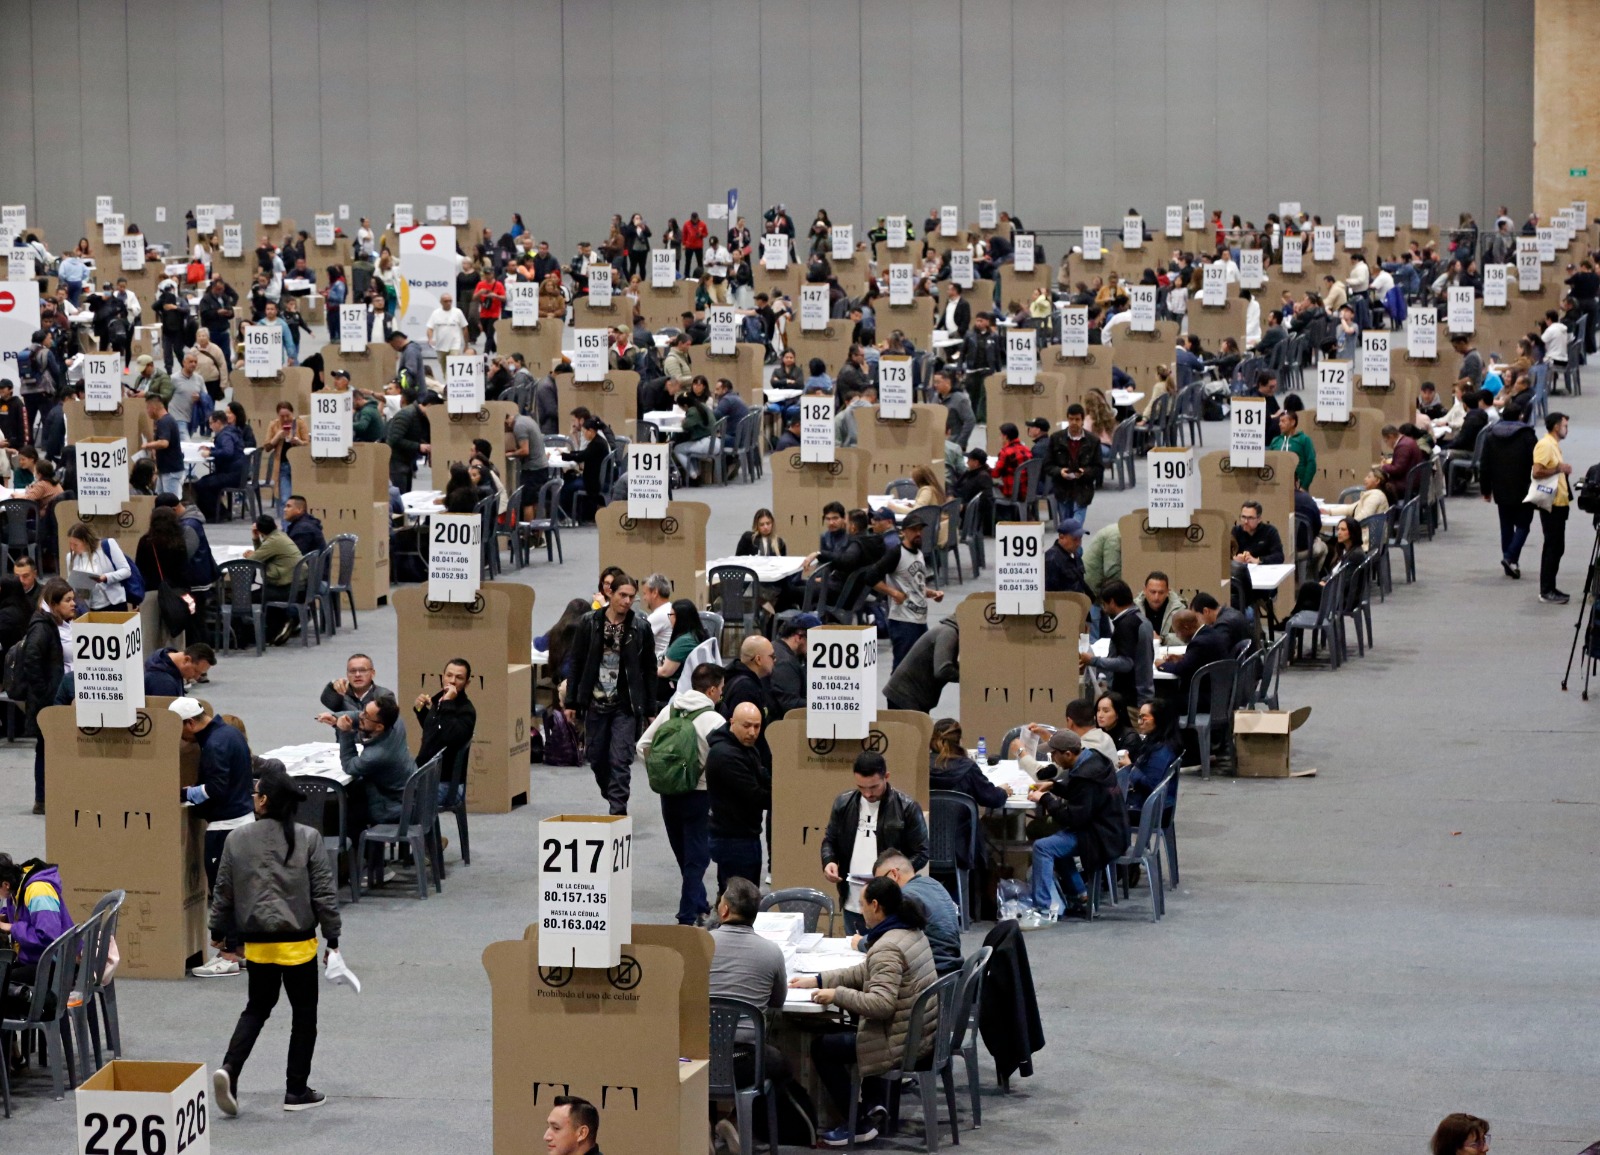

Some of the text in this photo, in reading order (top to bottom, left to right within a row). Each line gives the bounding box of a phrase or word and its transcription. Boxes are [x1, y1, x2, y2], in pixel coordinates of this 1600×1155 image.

[943, 209, 956, 217] 094
[1380, 210, 1393, 218] 092
[888, 220, 900, 228] 103
[1125, 221, 1138, 229] 102
[1347, 220, 1360, 228] 101
[0, 227, 9, 235] 05
[225, 229, 238, 237] 104
[834, 230, 849, 238] 112
[1085, 230, 1098, 238] 111
[1316, 230, 1331, 238] 110
[1537, 232, 1551, 240] 109
[123, 241, 136, 249] 113
[768, 239, 781, 247] 121
[1017, 240, 1032, 248] 120
[1286, 242, 1301, 250] 119
[10, 252, 24, 260] 122
[654, 254, 669, 263] 130
[953, 255, 969, 264] 129
[1242, 255, 1259, 264] 128
[1521, 257, 1537, 266] 127
[592, 271, 608, 281] 139
[891, 269, 907, 279] 138
[1205, 269, 1222, 279] 137
[1487, 270, 1503, 279] 136
[408, 279, 449, 289] No pase
[515, 287, 533, 298] 148
[803, 291, 821, 301] 147
[1134, 292, 1153, 303] 146
[1455, 292, 1471, 303] 145
[342, 310, 361, 322] 157
[712, 312, 732, 323] 156
[1063, 314, 1085, 326] 155
[1414, 314, 1435, 326] 154
[247, 332, 268, 345] 166
[271, 332, 281, 345] 166
[577, 335, 599, 348] 165
[1009, 338, 1031, 351] 164
[1364, 338, 1387, 351] 163
[89, 361, 106, 375] 175
[449, 363, 473, 376] 174
[882, 368, 906, 381] 173
[1319, 369, 1345, 384] 172
[317, 399, 337, 414] 183
[803, 404, 830, 420] 182
[1234, 409, 1262, 425] 181
[80, 451, 111, 469] 192
[112, 447, 127, 468] 192
[631, 453, 661, 471] 191
[1153, 461, 1186, 479] 190
[434, 522, 471, 545] 200
[998, 535, 1038, 557] 199
[432, 556, 469, 564] 80.041.406
[432, 572, 468, 580] 80.052.983
[76, 635, 121, 661] 209
[125, 627, 141, 660] 209
[812, 643, 860, 669] 208
[863, 639, 877, 668] 208
[78, 672, 123, 682] 80.110.863
[812, 682, 860, 690] 80.104.214
[78, 692, 124, 700] 80.116.586
[812, 702, 860, 710] 80.110.862
[543, 838, 605, 873] 217
[612, 834, 632, 873] 217
[544, 890, 607, 904] 80.157.135
[543, 918, 606, 931] 80.163.042
[537, 989, 576, 998] Prohibido
[614, 993, 641, 1001] celular
[176, 1090, 207, 1154] 226
[84, 1112, 167, 1155] 226
